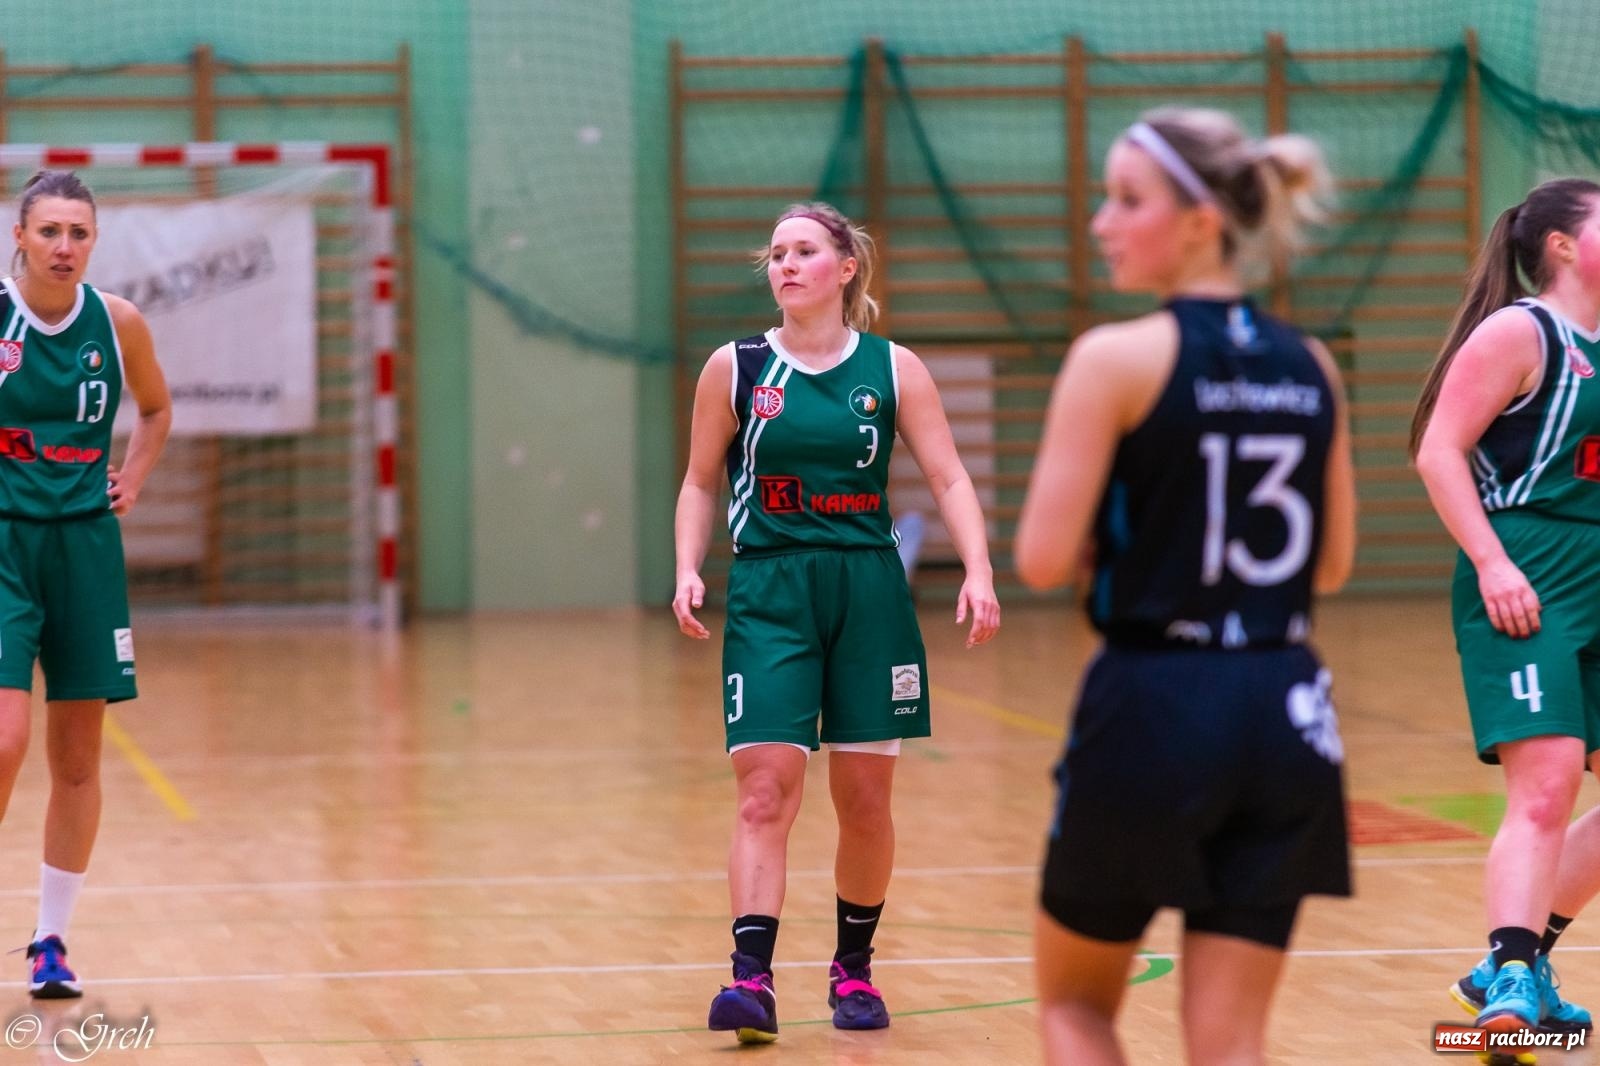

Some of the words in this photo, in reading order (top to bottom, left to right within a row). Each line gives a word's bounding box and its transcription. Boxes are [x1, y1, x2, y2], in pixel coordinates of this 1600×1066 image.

[76, 380, 108, 423] 13
[856, 424, 879, 469] 3
[766, 481, 793, 508] K
[810, 493, 881, 515] KAMAN
[1199, 433, 1315, 587] 13
[727, 672, 744, 724] 3
[1510, 663, 1543, 712] 4
